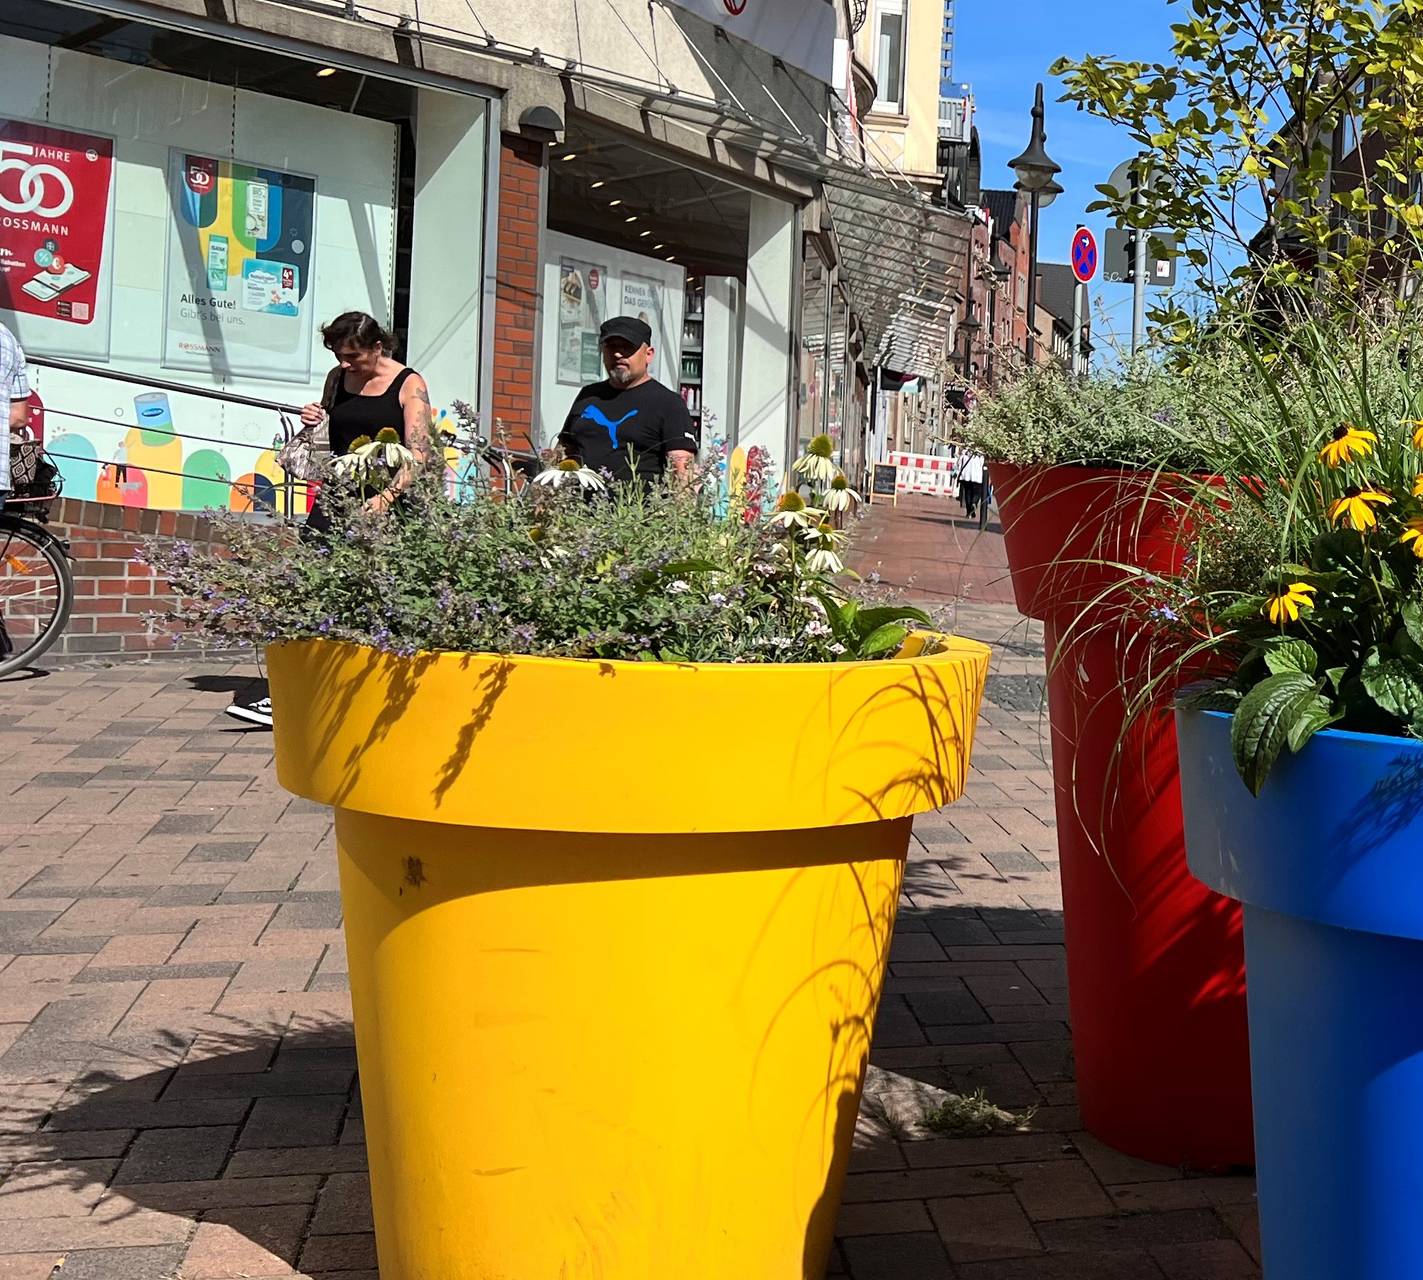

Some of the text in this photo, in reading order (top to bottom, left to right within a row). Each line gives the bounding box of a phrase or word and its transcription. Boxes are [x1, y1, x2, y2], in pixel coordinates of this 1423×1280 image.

[34, 147, 71, 162] JAHRE
[0, 215, 69, 236] OSSMANN
[180, 293, 237, 309] Alles Gute!
[210, 311, 224, 323] bei
[227, 317, 248, 326] uns.
[178, 342, 221, 353] ROSSMANN
